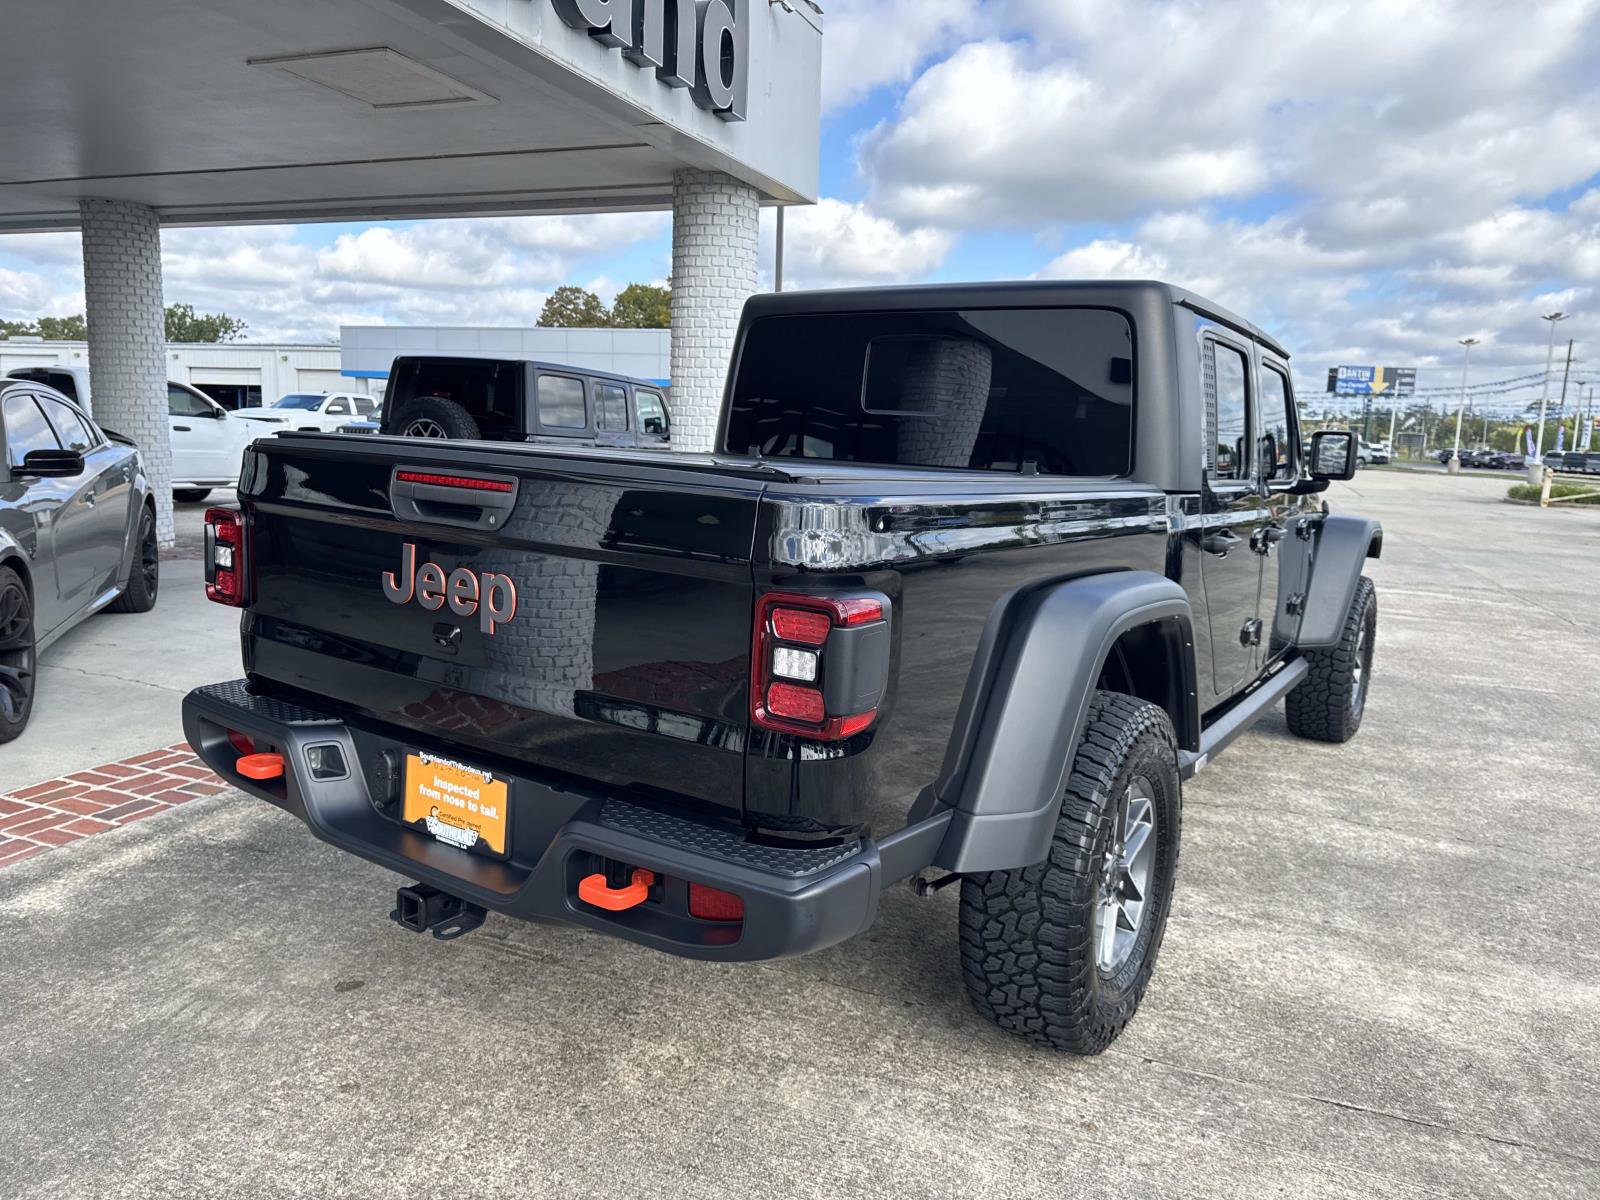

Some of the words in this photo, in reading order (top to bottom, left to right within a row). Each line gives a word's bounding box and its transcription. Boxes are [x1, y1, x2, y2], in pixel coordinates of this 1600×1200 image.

[381, 542, 518, 636] Jeep
[419, 783, 441, 801] from
[443, 793, 465, 809] nose
[467, 799, 478, 813] to
[480, 804, 499, 820] tail.
[433, 776, 480, 800] Inspected
